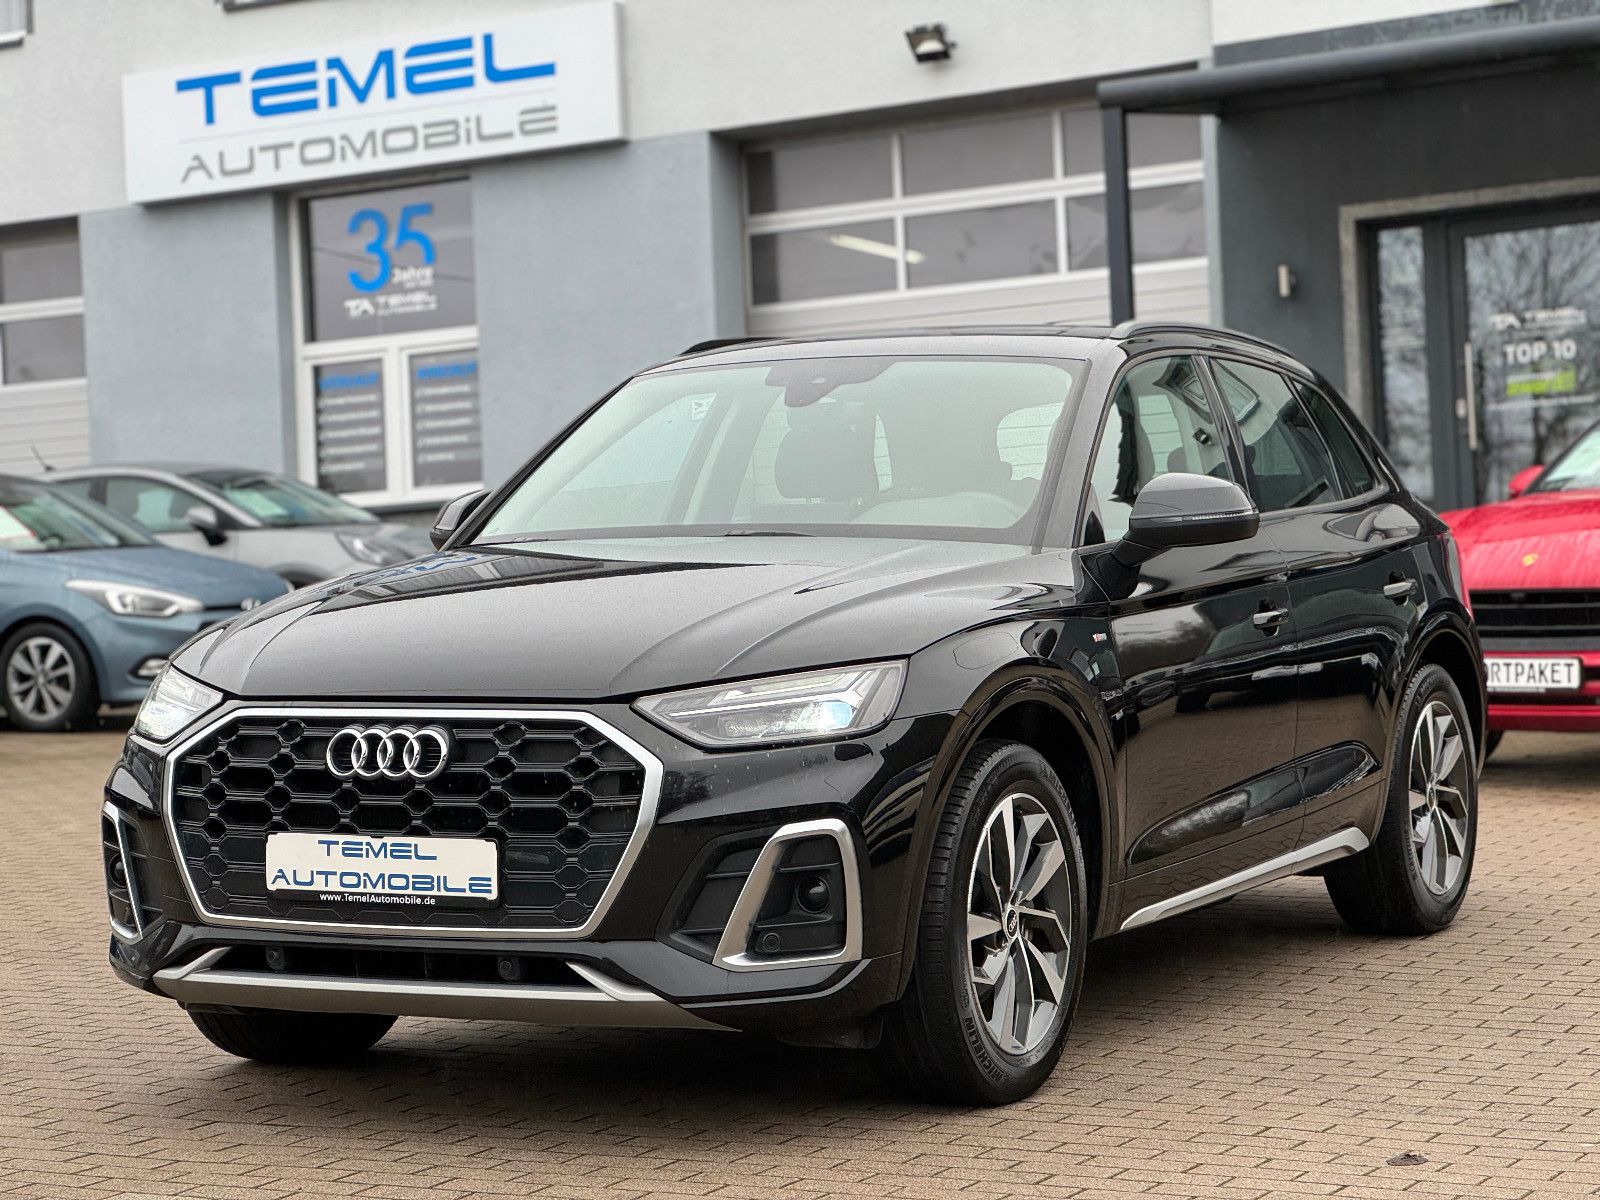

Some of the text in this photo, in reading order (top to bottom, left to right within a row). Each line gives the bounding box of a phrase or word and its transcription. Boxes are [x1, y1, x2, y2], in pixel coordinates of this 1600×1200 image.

[176, 32, 556, 126] TEMEL
[347, 202, 437, 293] 35
[1503, 338, 1577, 365] TOP 10
[317, 839, 438, 861] TEMEL
[271, 868, 492, 894] AUTOMOBILE
[319, 893, 436, 906] www.TemelAutomobile.de
[964, 1016, 1006, 1081] MICHELIN
